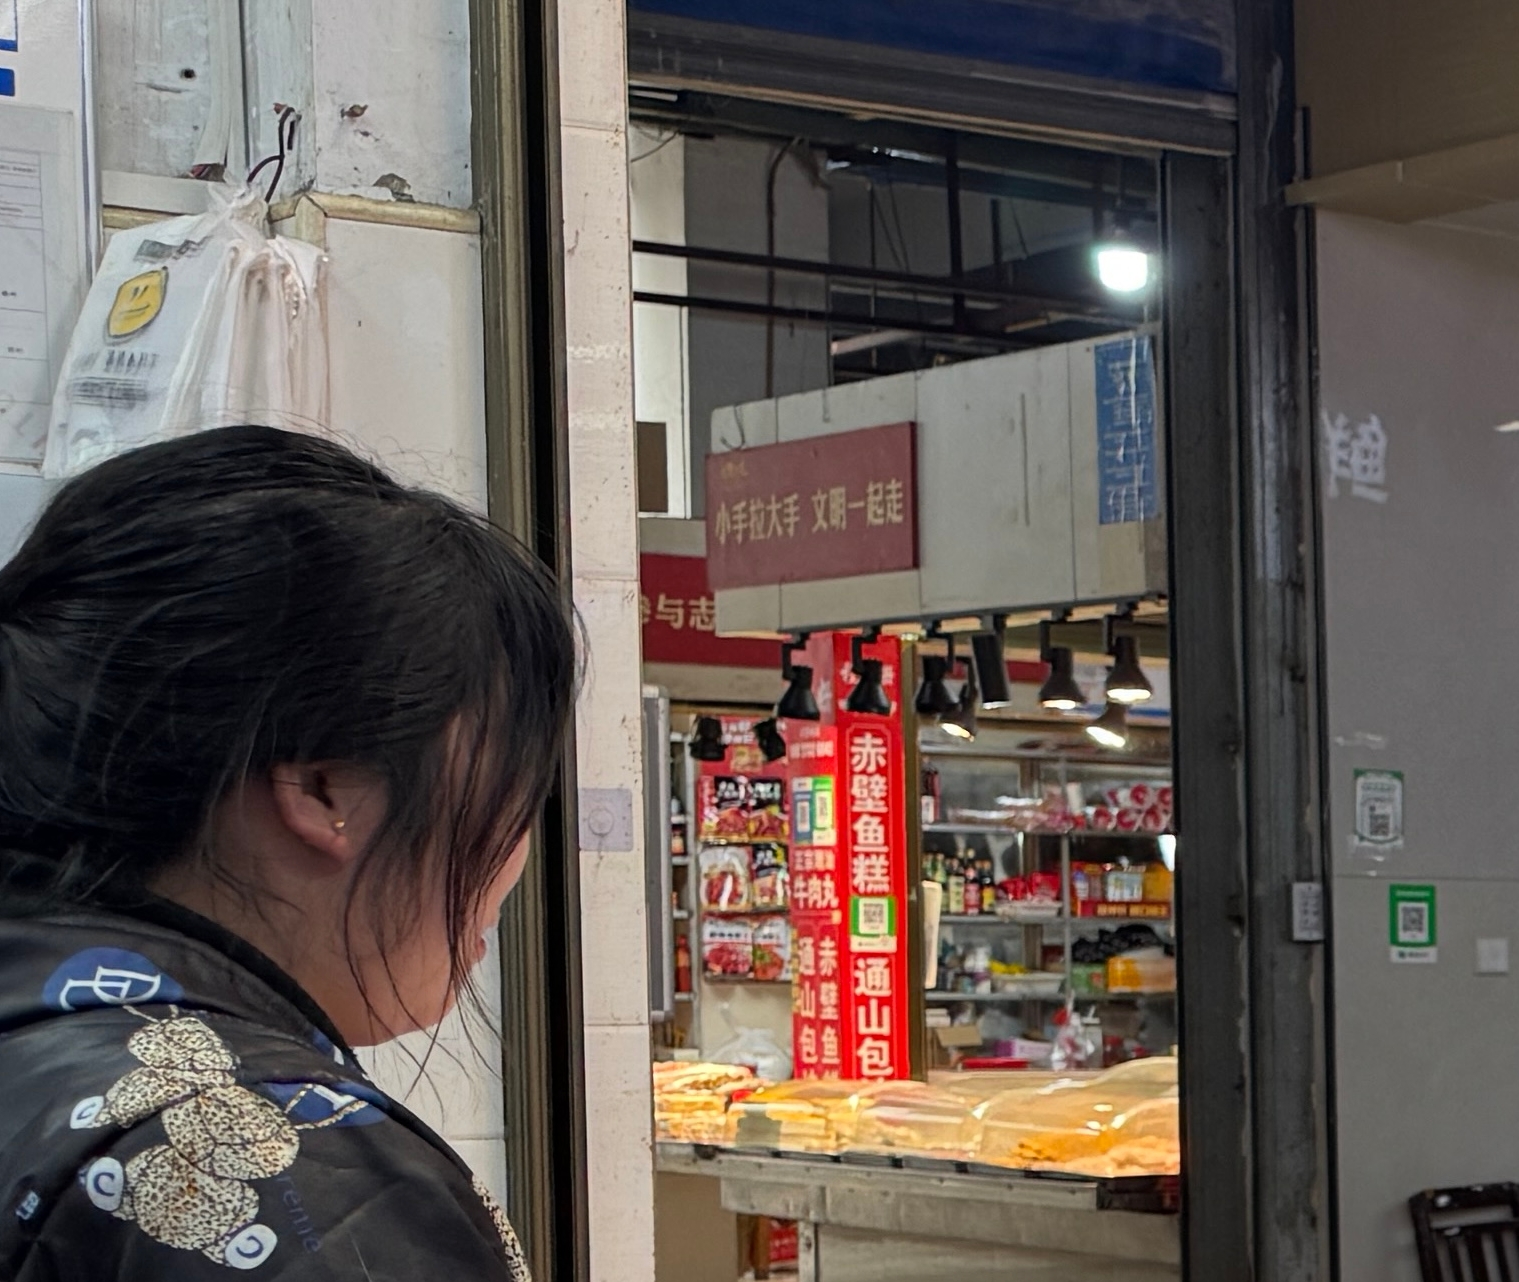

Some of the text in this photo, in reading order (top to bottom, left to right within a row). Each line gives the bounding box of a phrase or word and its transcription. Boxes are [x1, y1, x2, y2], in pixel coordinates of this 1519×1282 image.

[714, 478, 904, 546] 小手拉大手 文明一起走
[850, 732, 892, 894] 赤壁鱼糕
[852, 956, 895, 1080] 通山包
